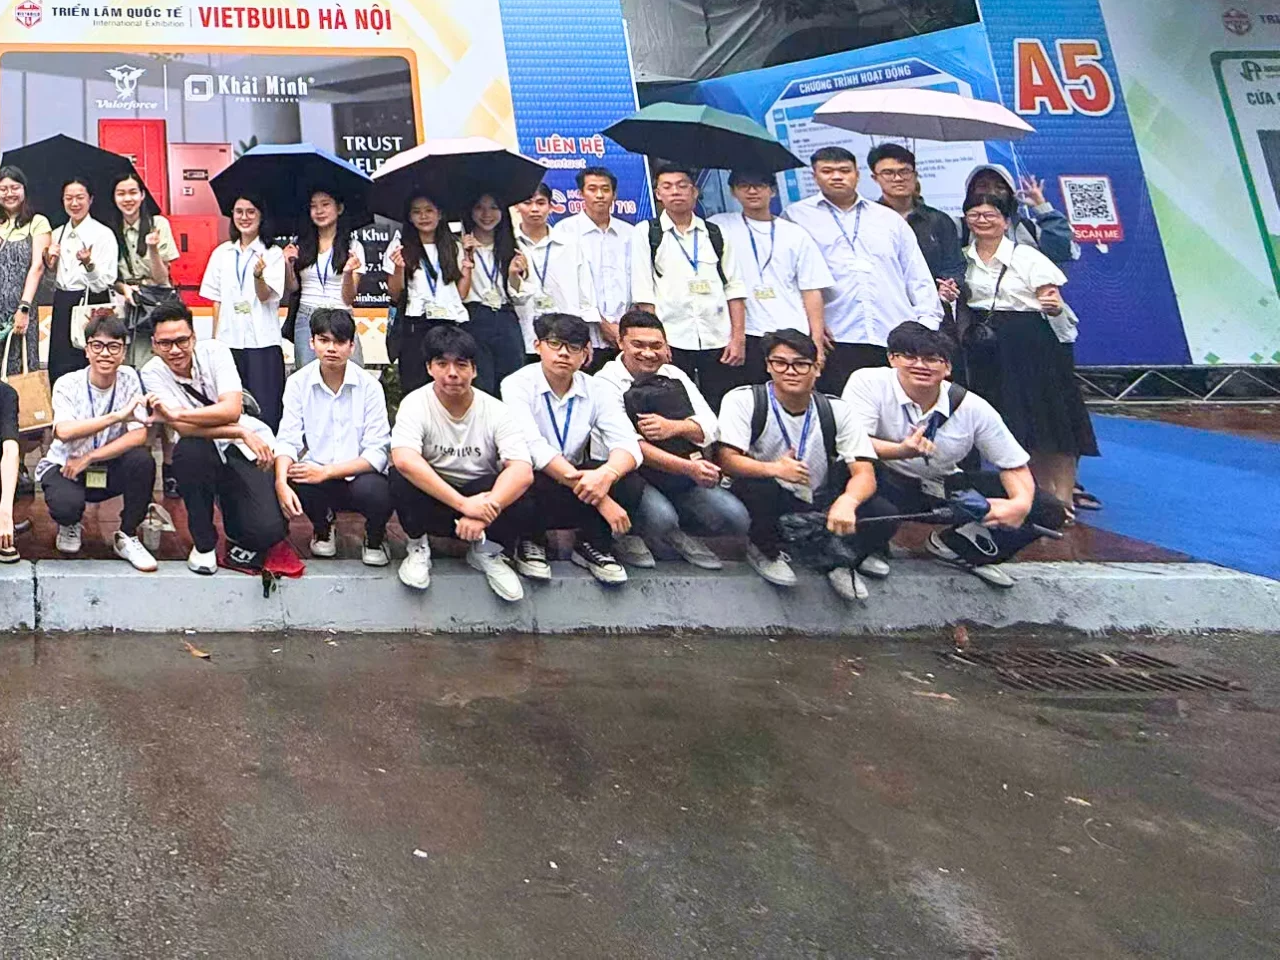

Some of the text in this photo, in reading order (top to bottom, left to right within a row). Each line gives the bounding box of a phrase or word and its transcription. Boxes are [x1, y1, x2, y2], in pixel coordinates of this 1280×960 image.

[52, 4, 90, 17] TRIỂN
[127, 5, 161, 18] QUỐC
[166, 6, 183, 18] TẾ
[198, 7, 310, 29] VIETBUILD
[318, 3, 348, 30] HÀ
[355, 4, 392, 35] NỘI
[218, 74, 308, 96] Khải Minh
[799, 64, 911, 94] CHƯƠNG TRÌNH HOẠT ĐỘNG
[1014, 38, 1115, 116] A5
[95, 99, 158, 110] Valorforce
[342, 136, 403, 151] TRUST
[536, 134, 605, 158] LIÊN HỆ
[362, 228, 389, 242] Khu
[1075, 228, 1120, 239] SCAN ME
